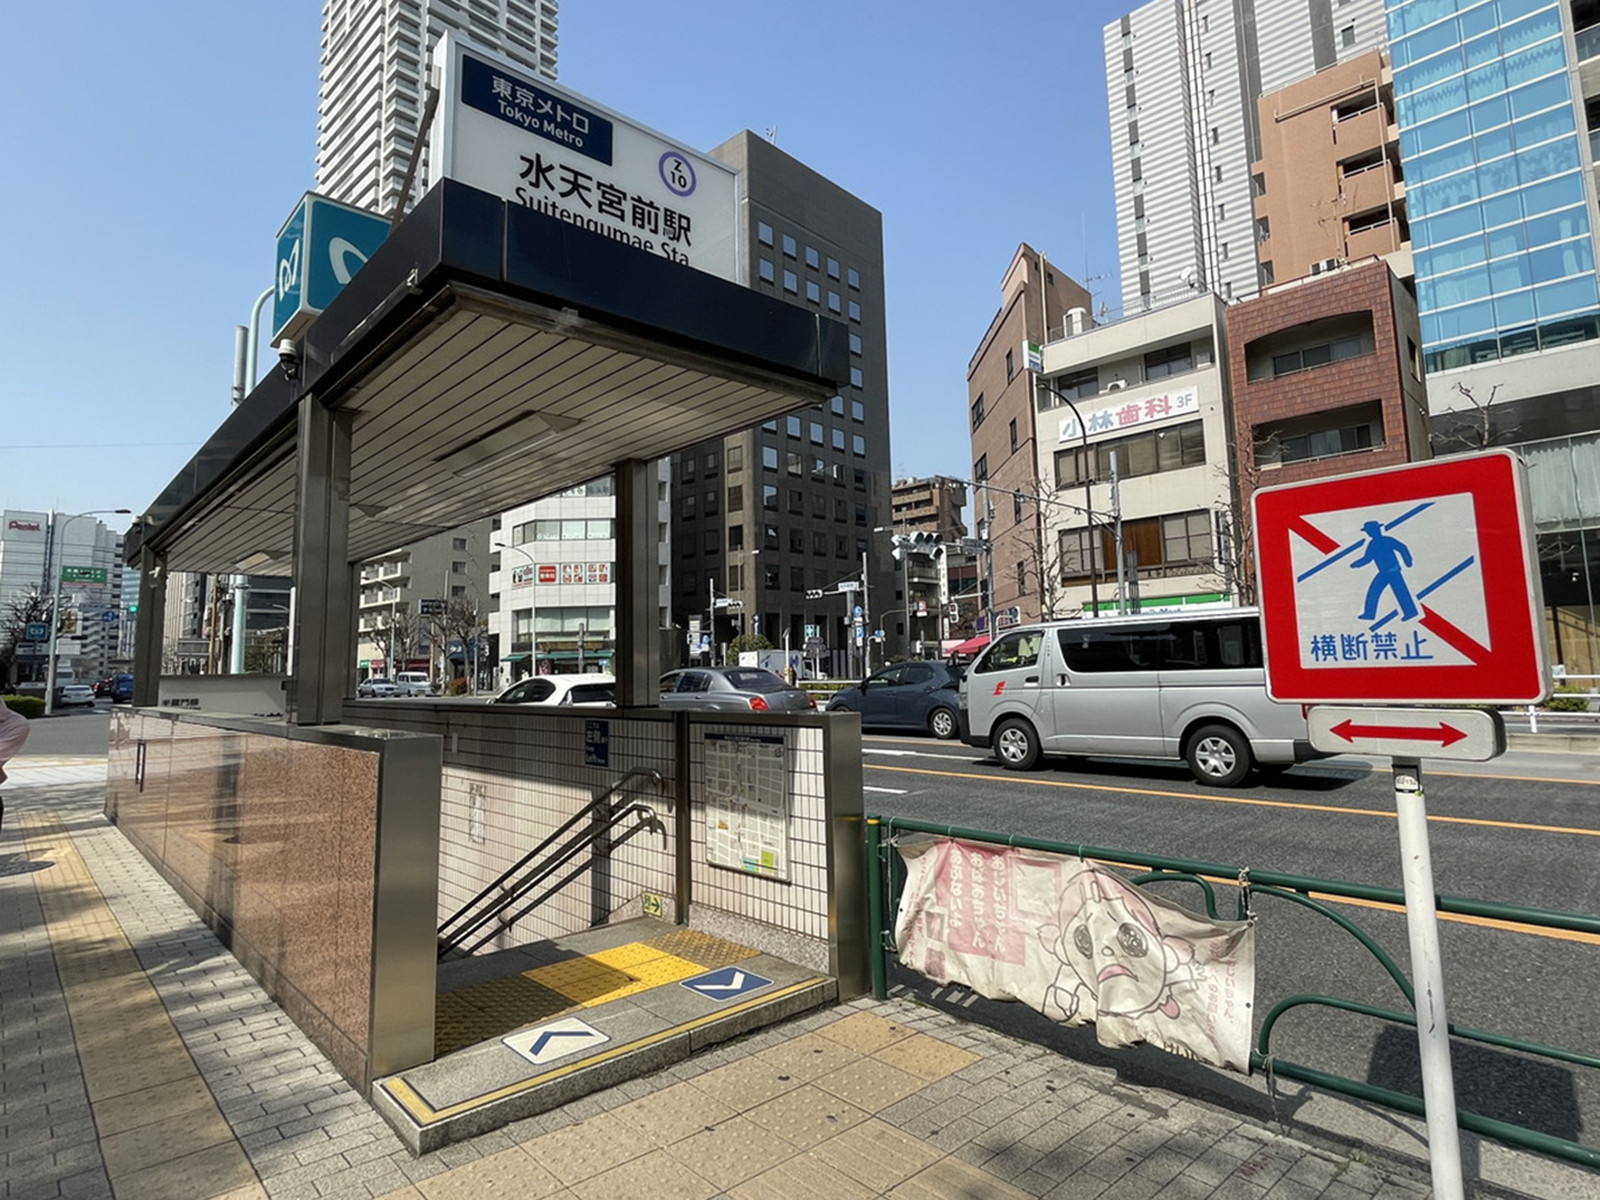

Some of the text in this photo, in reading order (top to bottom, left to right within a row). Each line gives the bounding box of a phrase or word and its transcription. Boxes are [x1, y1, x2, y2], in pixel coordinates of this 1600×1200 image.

[491, 75, 589, 134] 東京メトロ
[497, 99, 584, 148] Tokyo Metro
[669, 172, 688, 189] 10
[672, 158, 683, 173] Z
[519, 151, 692, 248] 水天宮前駅
[1061, 393, 1193, 438] 小林歯科 3F
[1310, 630, 1434, 662] 横断禁止
[949, 848, 964, 929] あぶないよ
[969, 851, 987, 949] おばあちゃん
[990, 854, 1007, 954] おじいちゃん
